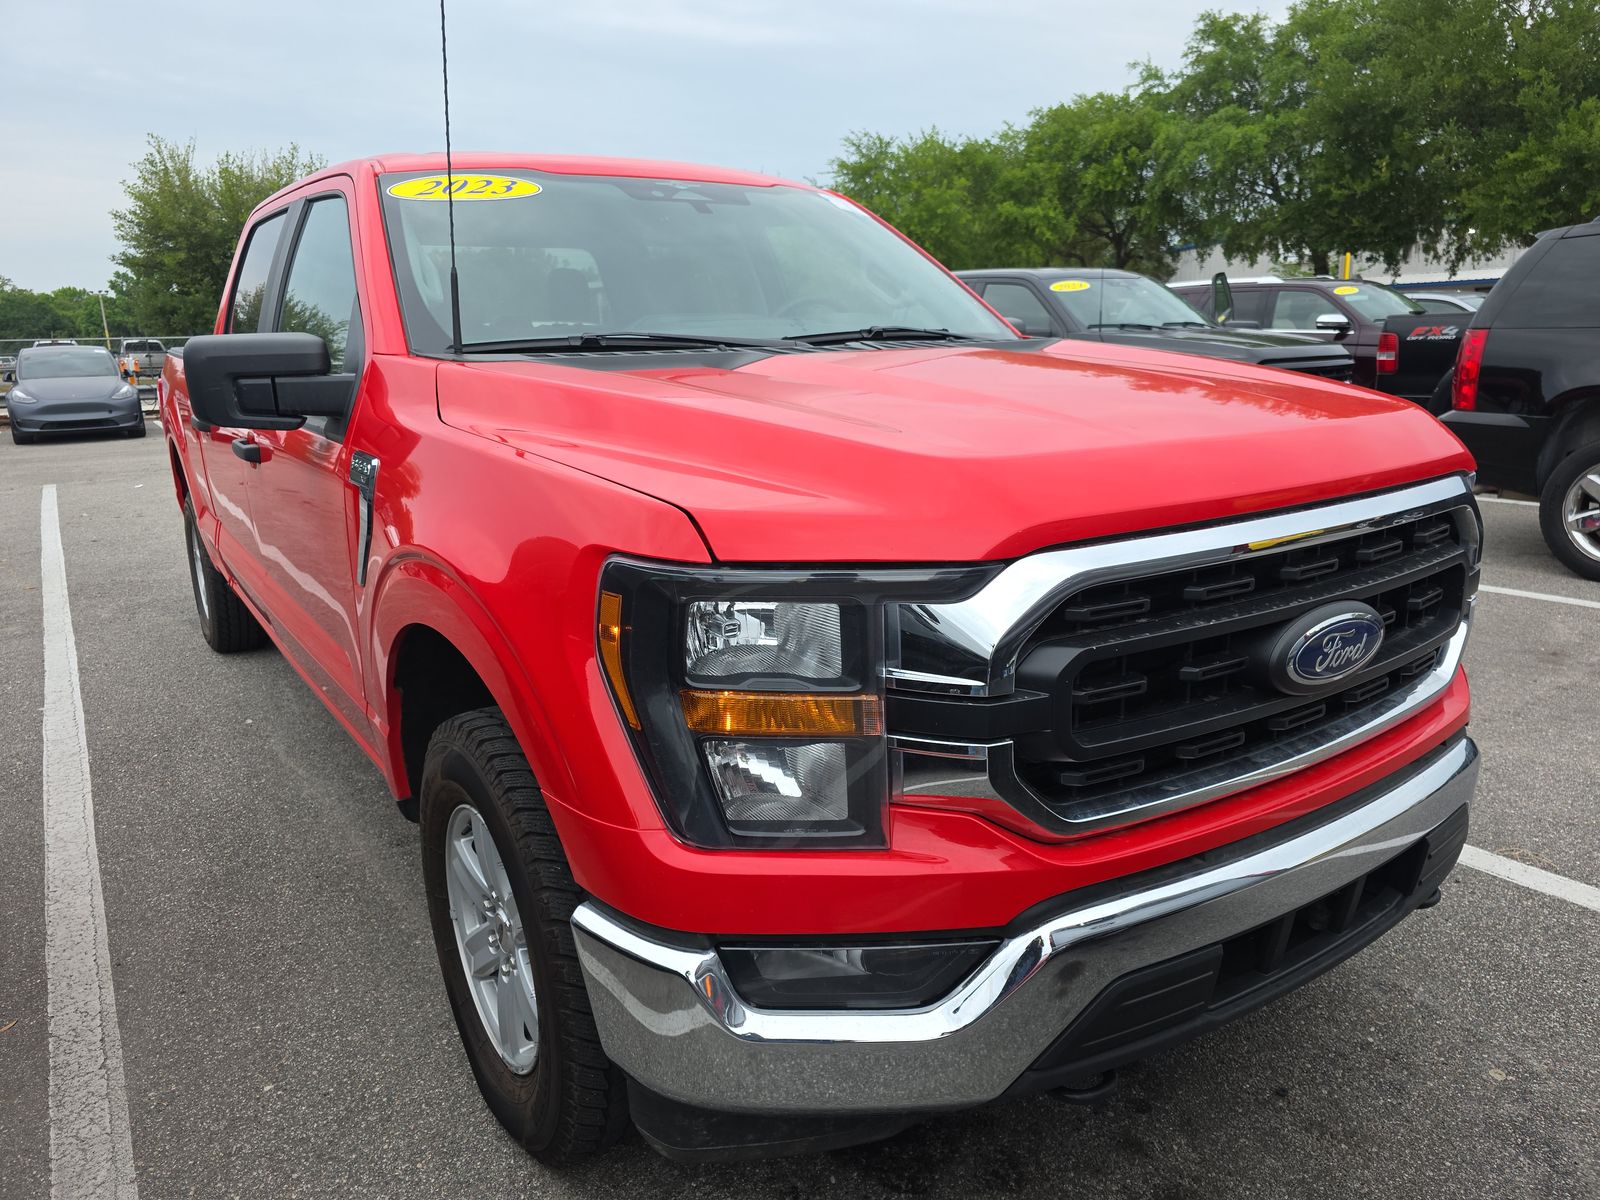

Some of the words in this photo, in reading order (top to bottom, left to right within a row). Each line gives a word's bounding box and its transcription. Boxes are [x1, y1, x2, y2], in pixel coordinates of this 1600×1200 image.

[415, 180, 518, 196] 2023
[1409, 326, 1459, 336] FX4
[1315, 629, 1368, 672] Ford
